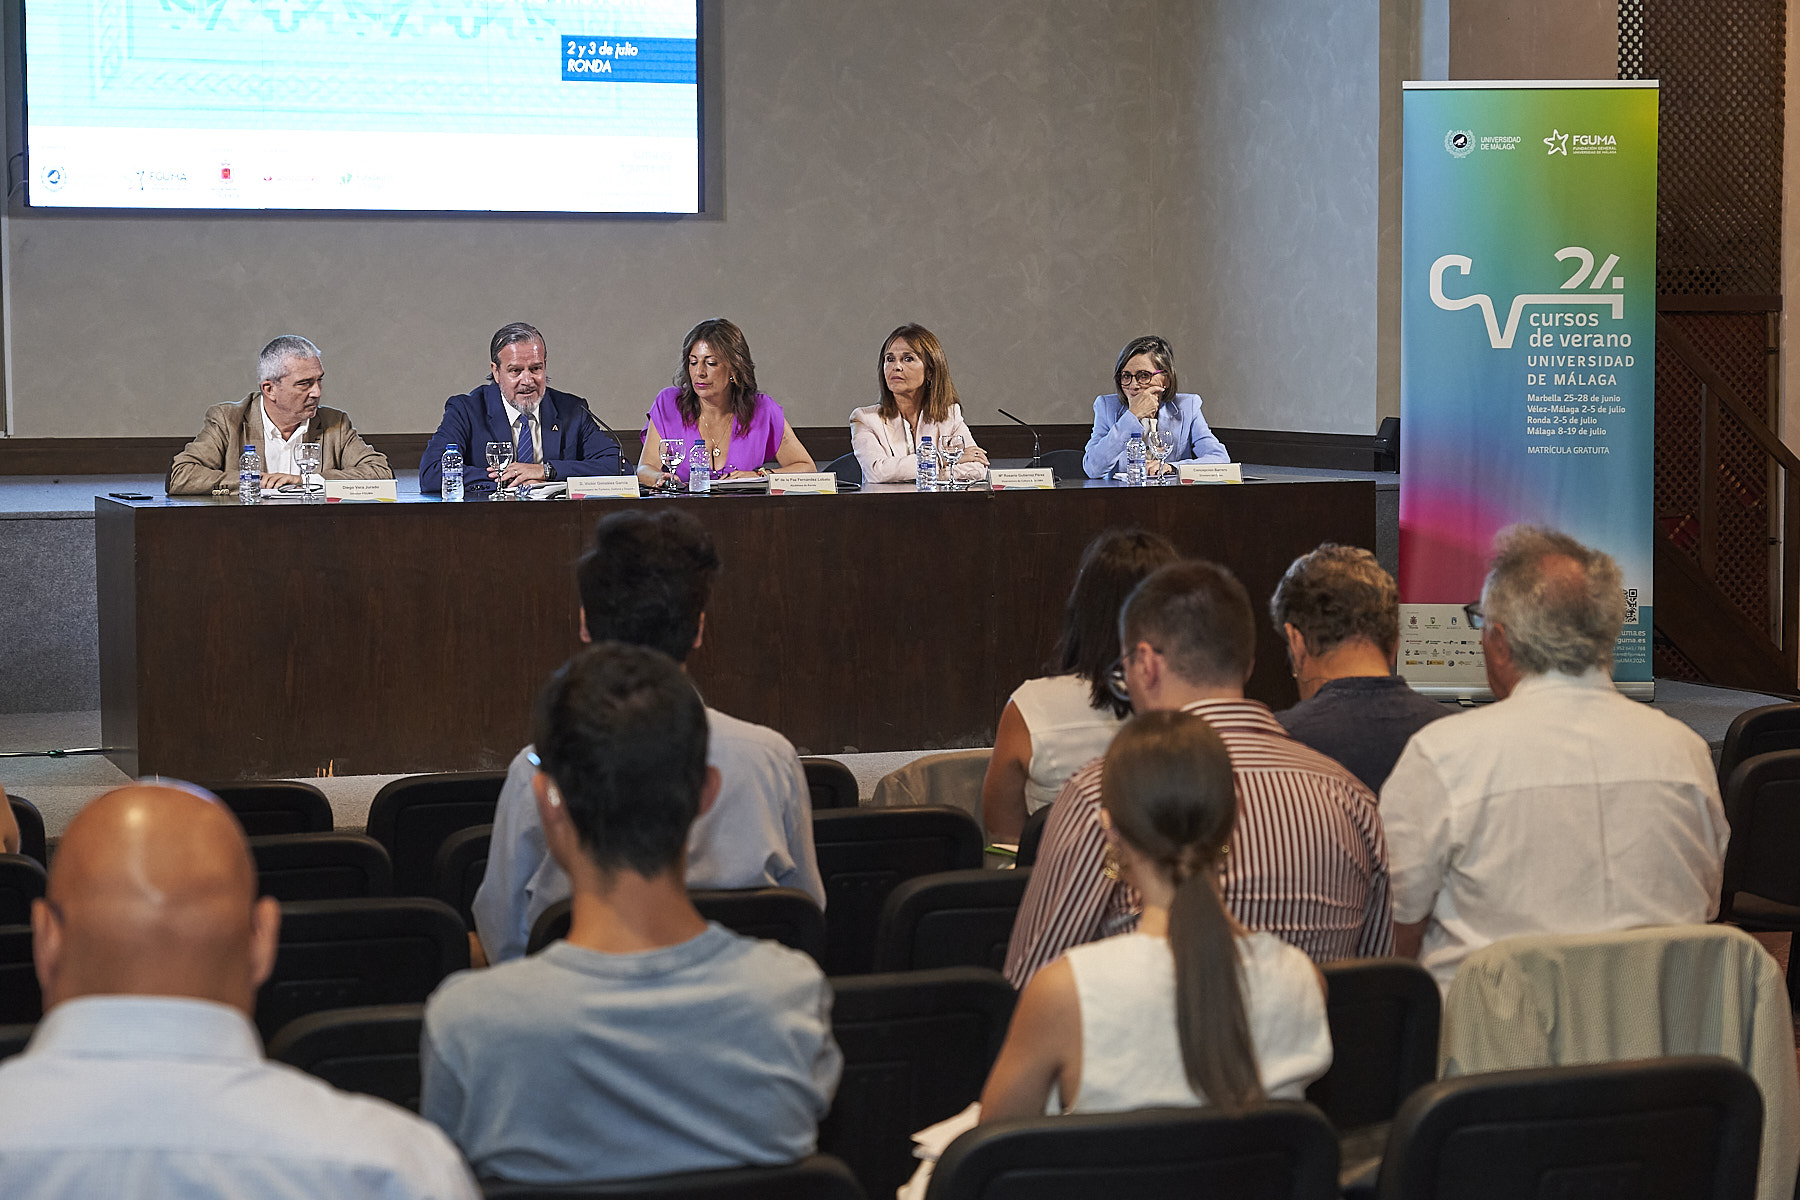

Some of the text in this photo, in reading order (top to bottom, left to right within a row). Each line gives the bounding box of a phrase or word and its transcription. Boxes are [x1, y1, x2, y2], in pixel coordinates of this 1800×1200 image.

[567, 41, 638, 59] 2 y 3 de julio
[567, 58, 612, 73] RONDA
[1573, 135, 1617, 146] FGUMA
[1529, 312, 1599, 327] cursos
[1529, 328, 1632, 348] de verano
[1527, 355, 1635, 367] UNIVERSIDAD
[1527, 371, 1617, 386] DE MÁLAGA
[1601, 395, 1621, 403] junio
[1527, 405, 1579, 414] Vélez-Málaga
[1608, 406, 1625, 414] julio
[1580, 416, 1597, 425] julio
[1527, 427, 1555, 436] Málaga
[1589, 428, 1606, 436] julio
[1528, 445, 1572, 454] MATRÍCULA
